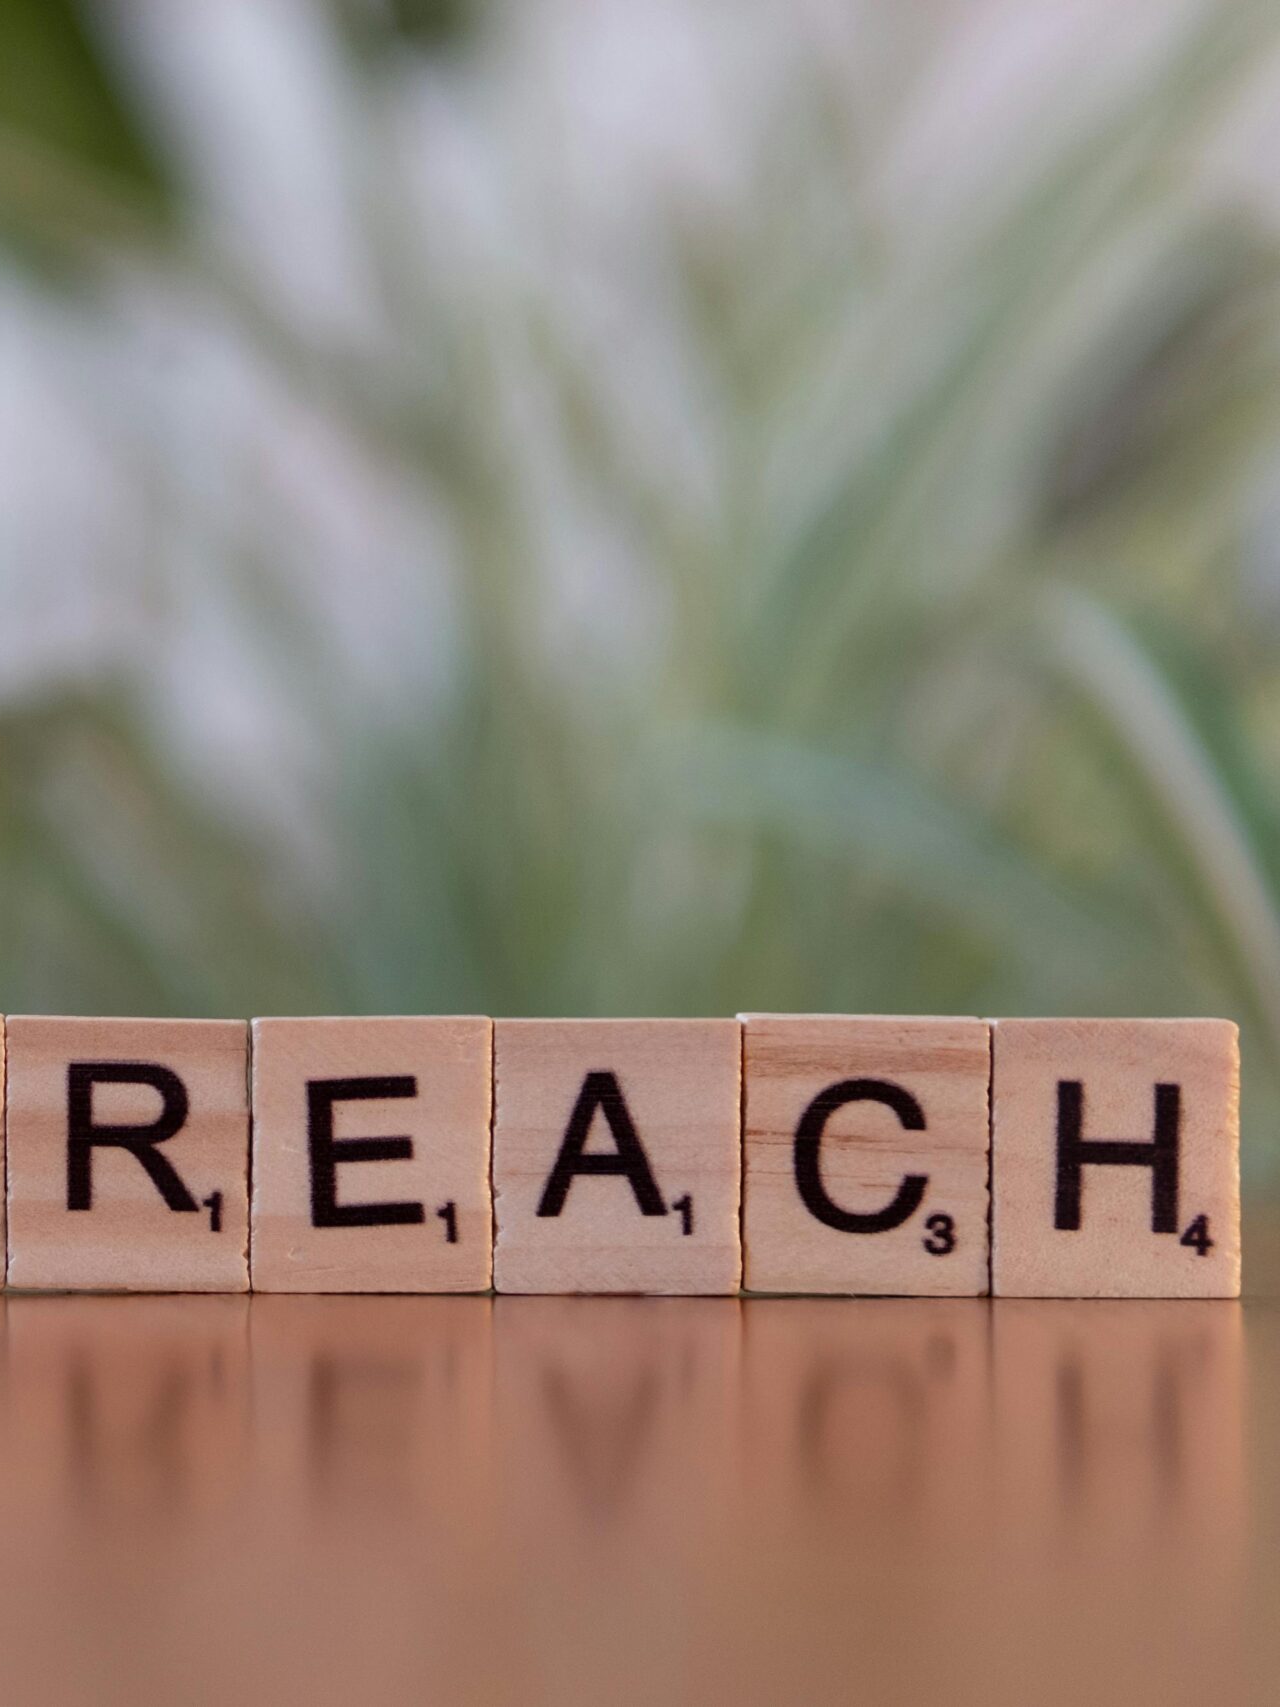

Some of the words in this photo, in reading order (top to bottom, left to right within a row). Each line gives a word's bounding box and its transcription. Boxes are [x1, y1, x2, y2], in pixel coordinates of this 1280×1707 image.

[202, 1190, 224, 1233] 1
[436, 1201, 459, 1244] 1
[671, 1194, 694, 1236] 1
[924, 1213, 957, 1257] 3
[1180, 1214, 1214, 1257] 4
